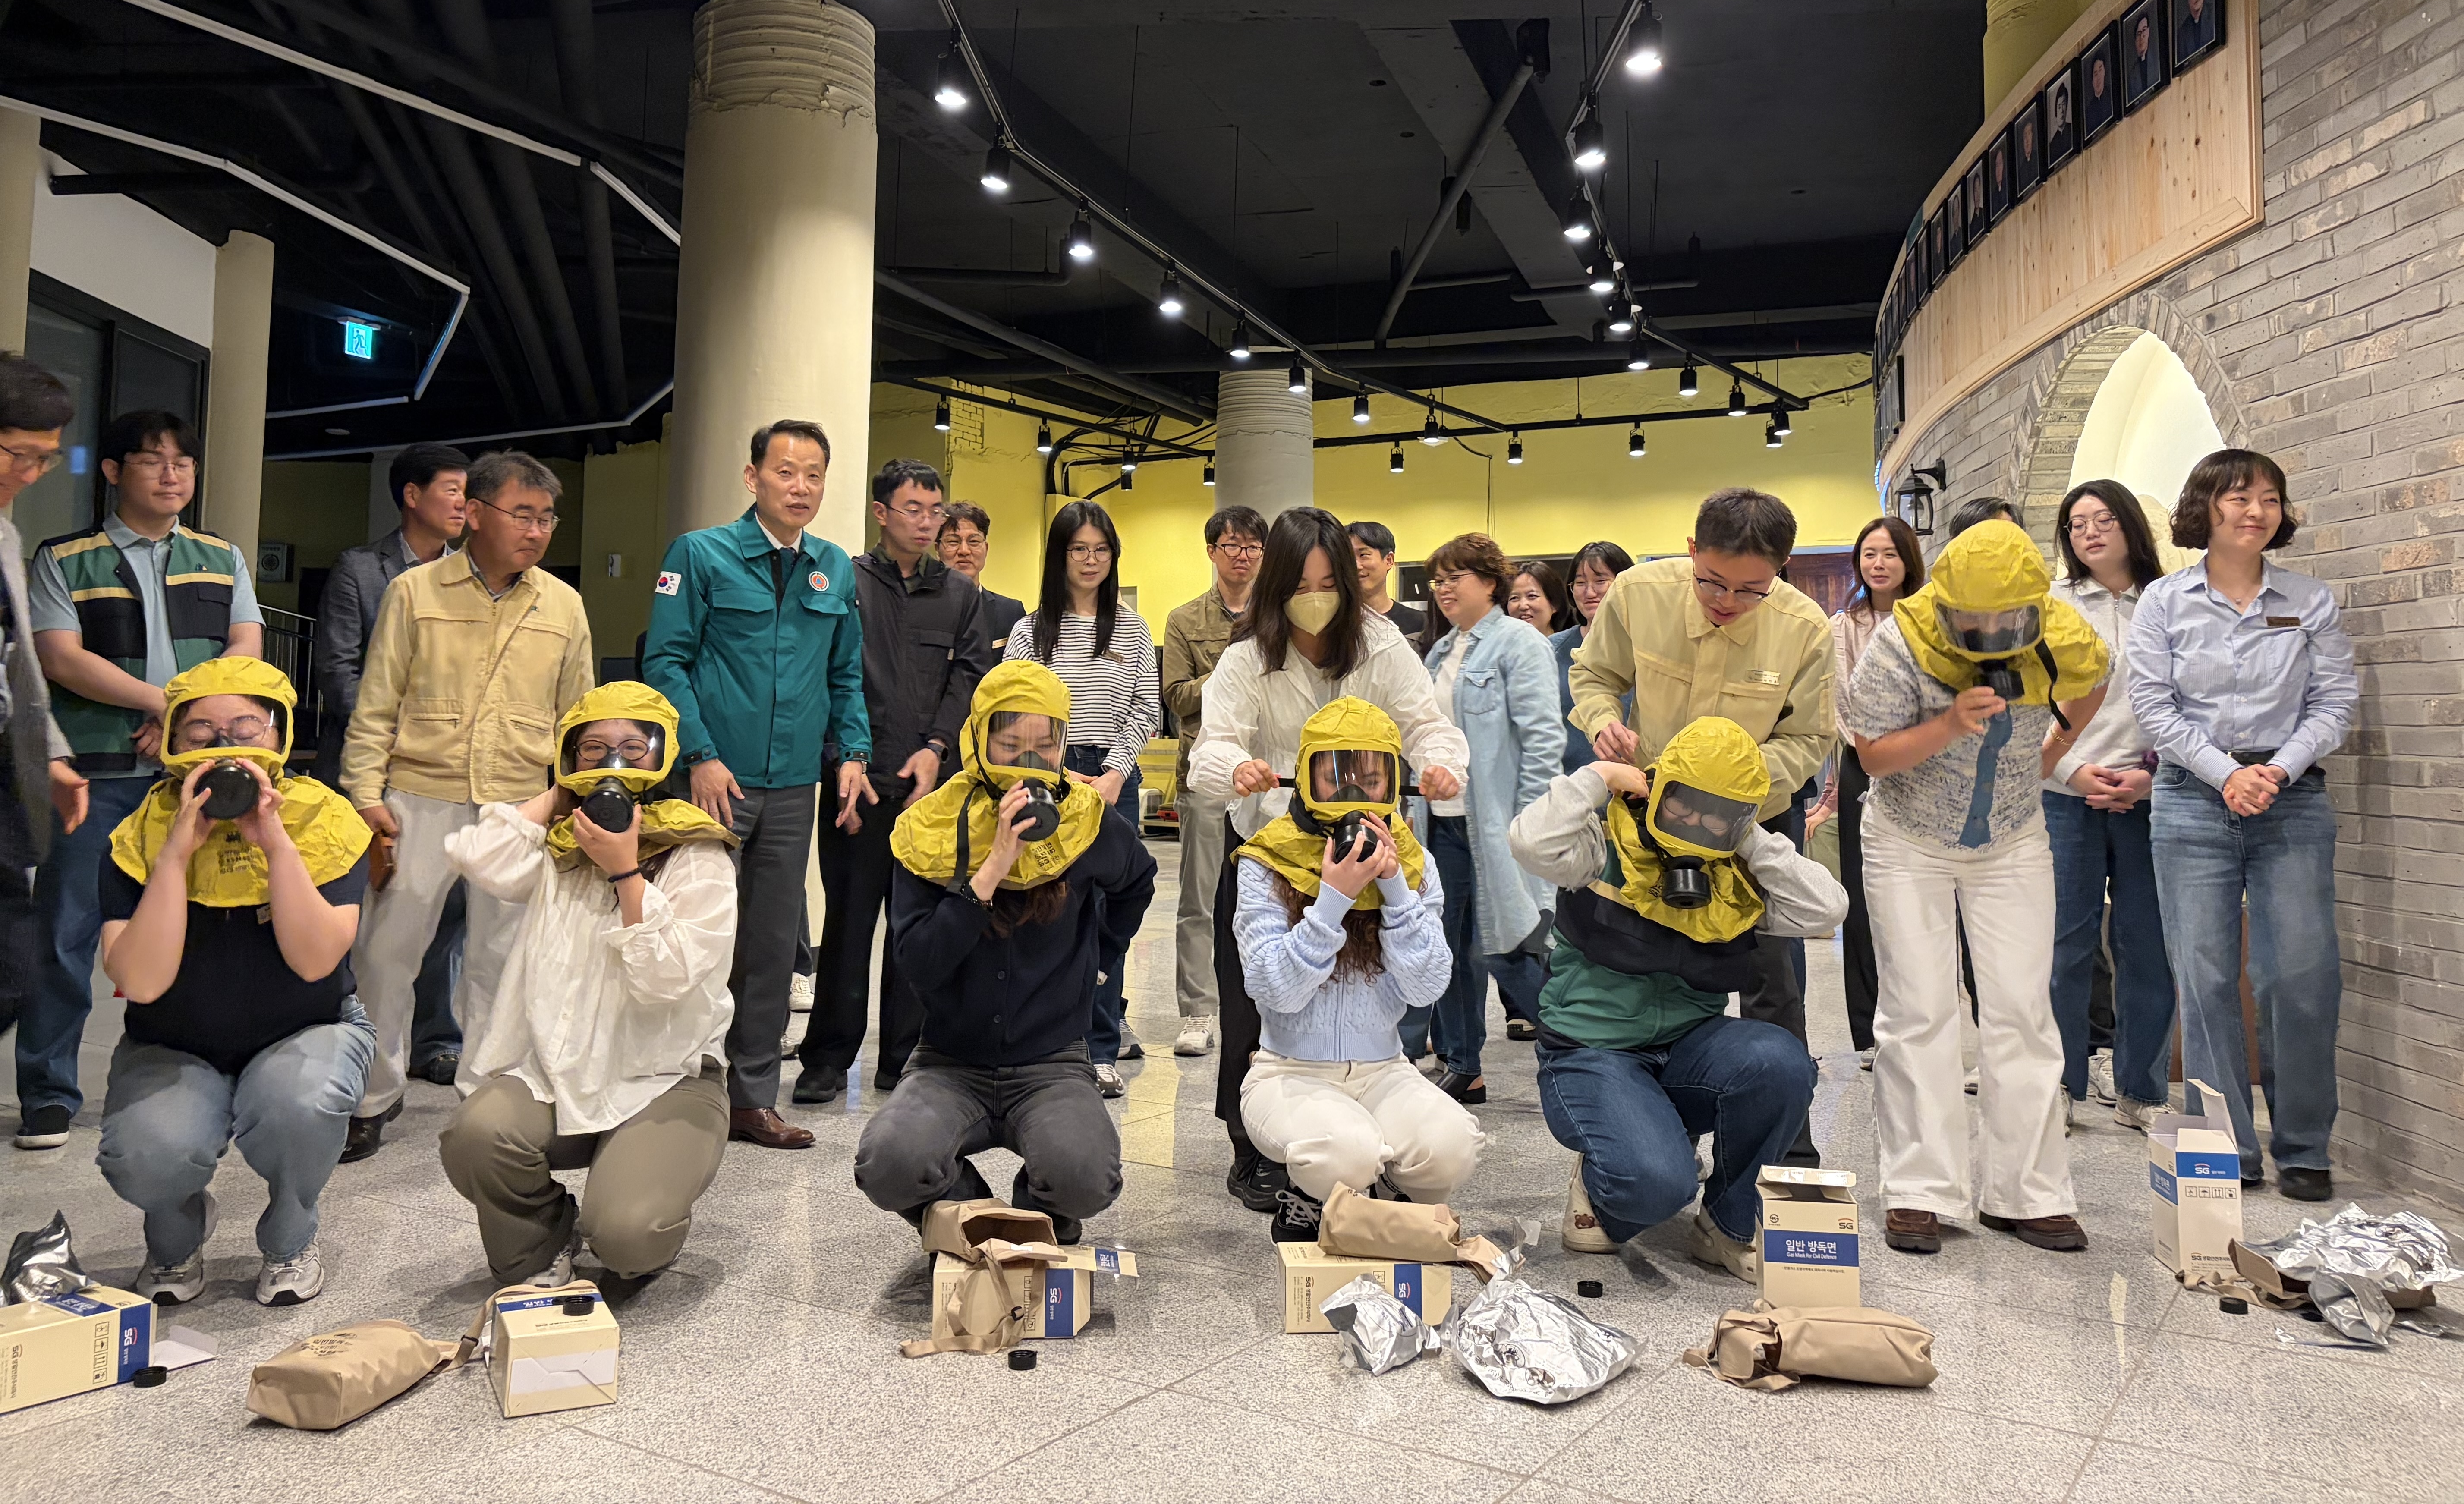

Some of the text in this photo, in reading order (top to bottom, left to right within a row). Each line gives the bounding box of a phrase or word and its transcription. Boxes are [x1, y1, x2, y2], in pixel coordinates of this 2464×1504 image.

[1785, 1240, 1837, 1254] 일반 방독면
[1306, 1277, 1311, 1287] SG
[1050, 1288, 1057, 1303] SG
[1399, 1283, 1406, 1298] SG
[124, 1328, 132, 1347] SG
[12, 1345, 19, 1359] SG
